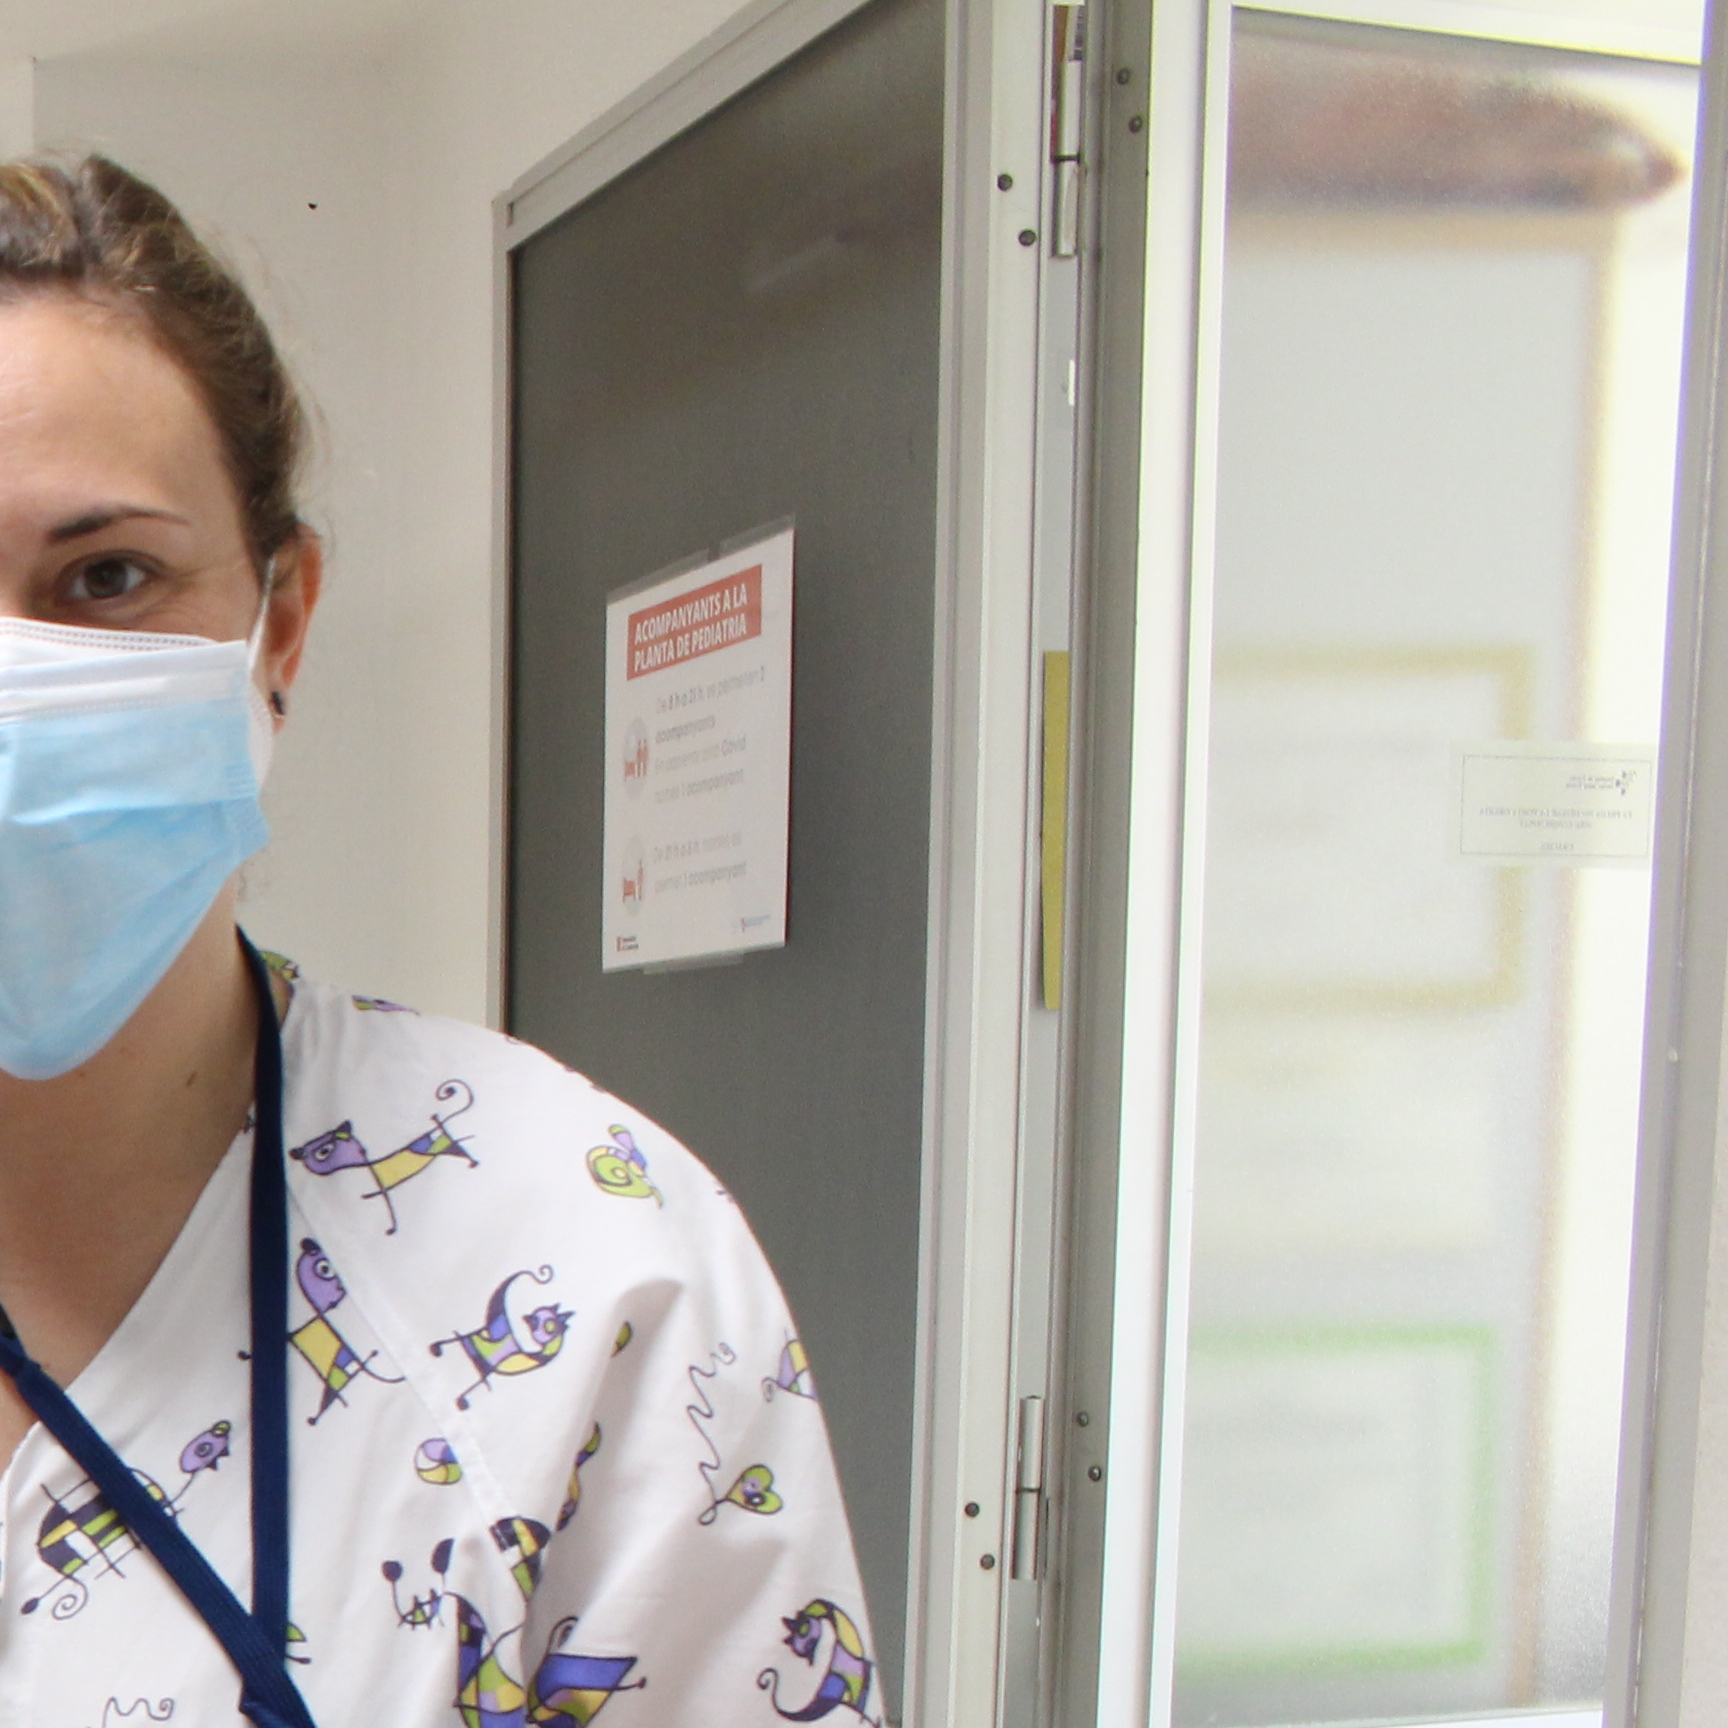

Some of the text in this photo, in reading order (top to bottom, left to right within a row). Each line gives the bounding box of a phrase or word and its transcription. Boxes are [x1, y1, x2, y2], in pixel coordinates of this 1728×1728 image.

[634, 583, 748, 646] ACOMPANYANTS A LA
[634, 612, 748, 674] PLANTA DE PEDIATRIA
